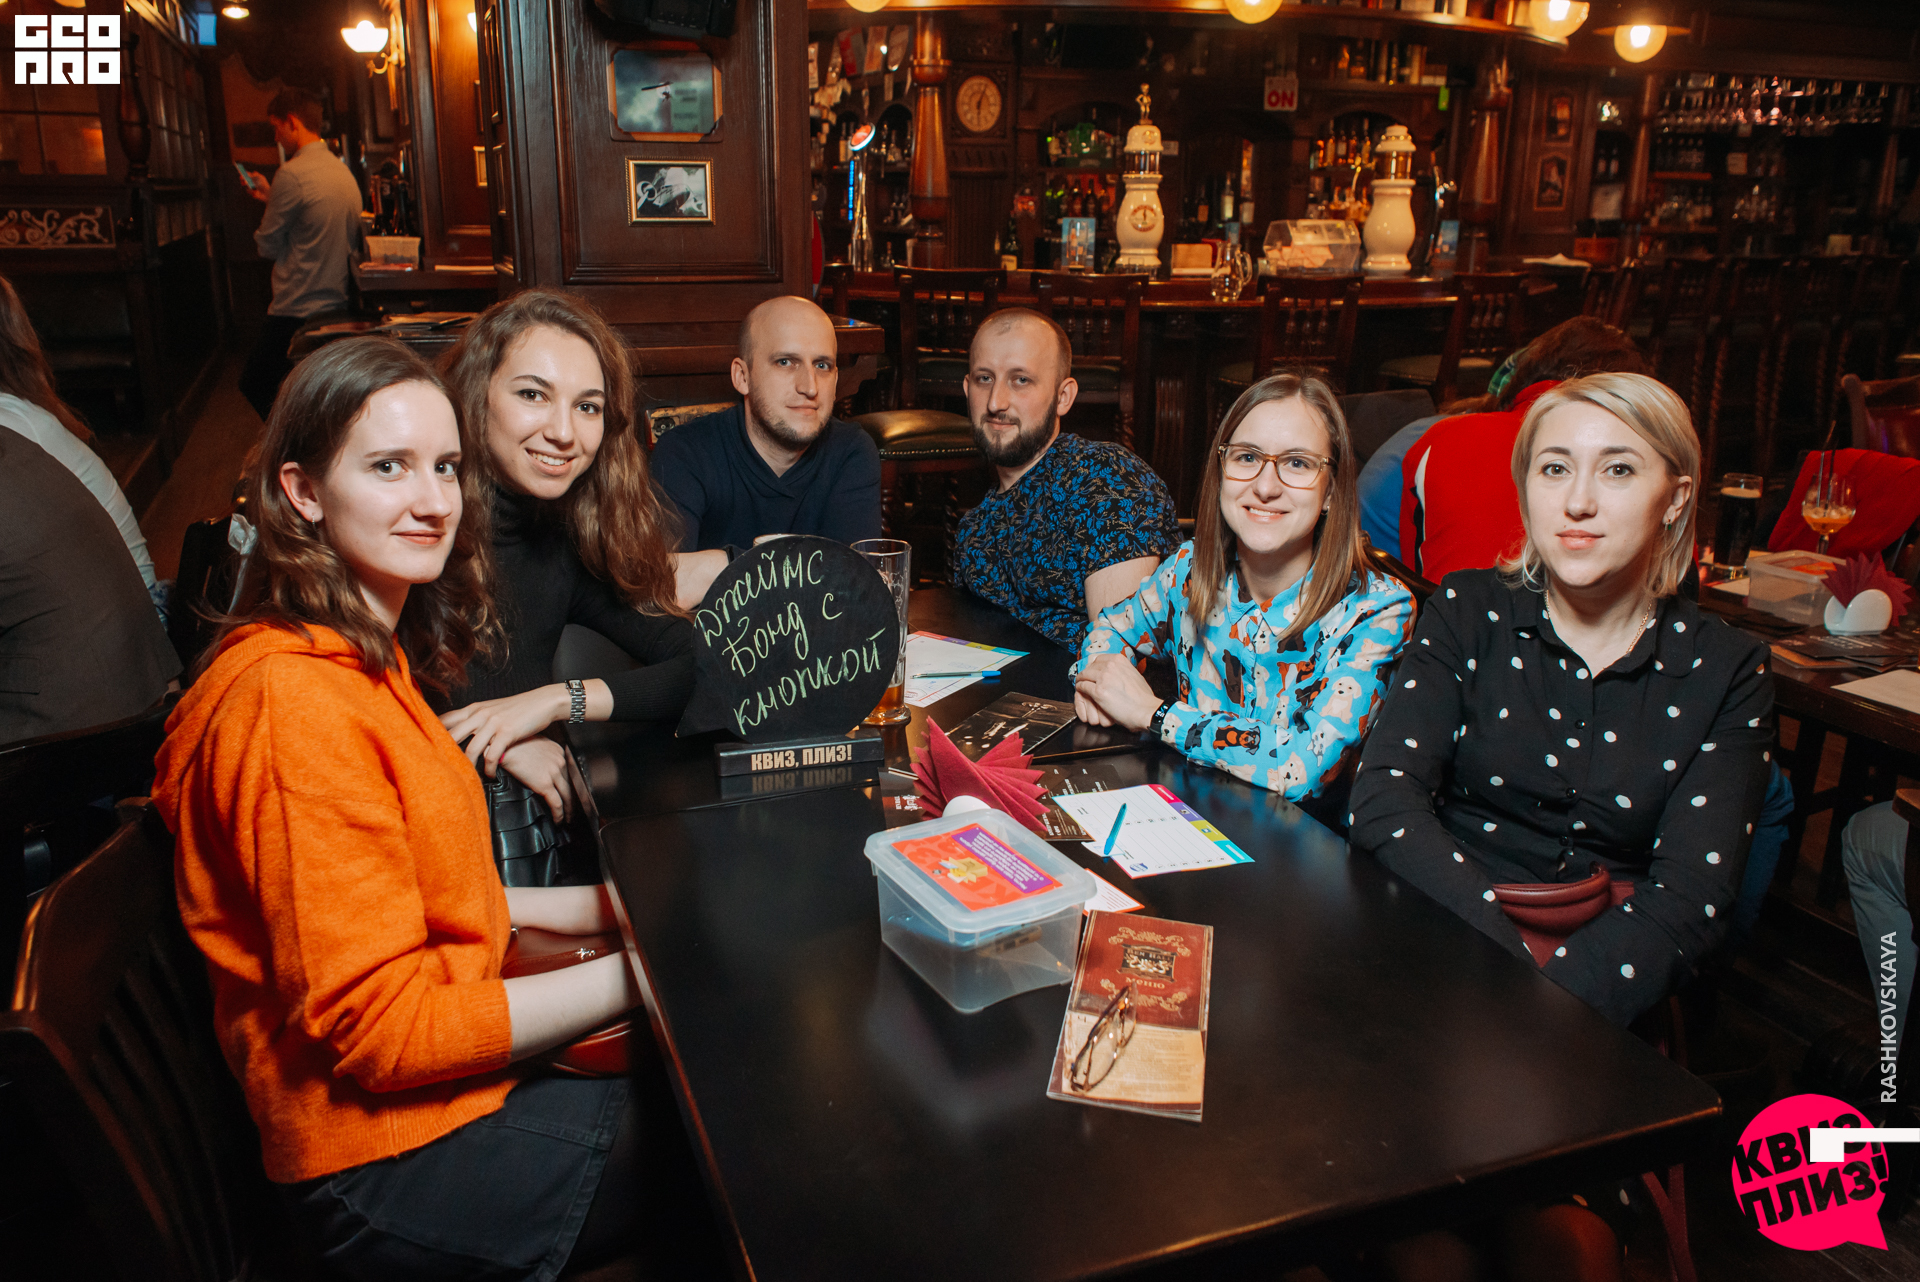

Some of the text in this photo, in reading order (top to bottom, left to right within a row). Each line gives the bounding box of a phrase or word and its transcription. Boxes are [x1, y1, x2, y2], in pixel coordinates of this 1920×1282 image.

[1267, 90, 1295, 108] ON
[722, 602, 809, 678] Бонд
[751, 745, 852, 772] КВИЗ, ПЛИЗ!
